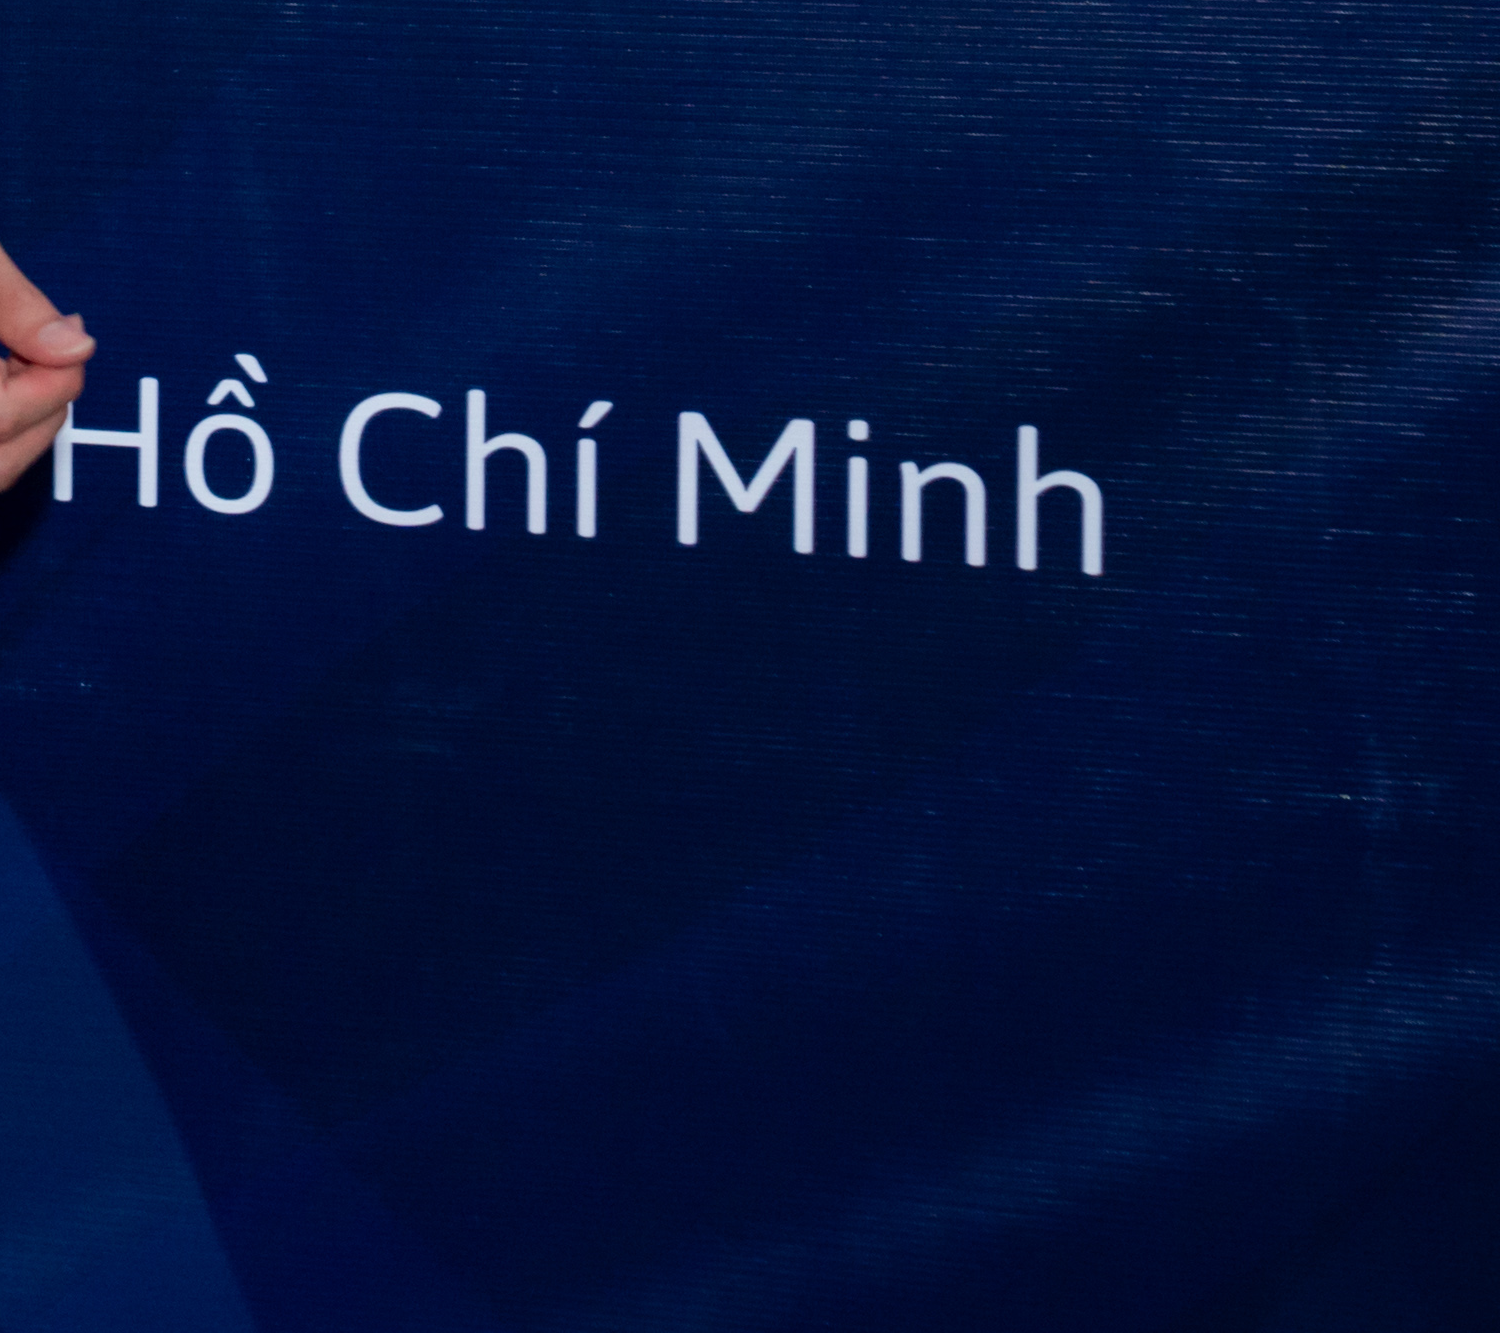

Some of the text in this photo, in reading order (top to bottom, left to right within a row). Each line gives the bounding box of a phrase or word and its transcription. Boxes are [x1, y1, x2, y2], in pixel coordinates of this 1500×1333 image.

[52, 352, 276, 515] Hồ
[338, 388, 615, 539] Chí
[676, 410, 1106, 577] Minh
